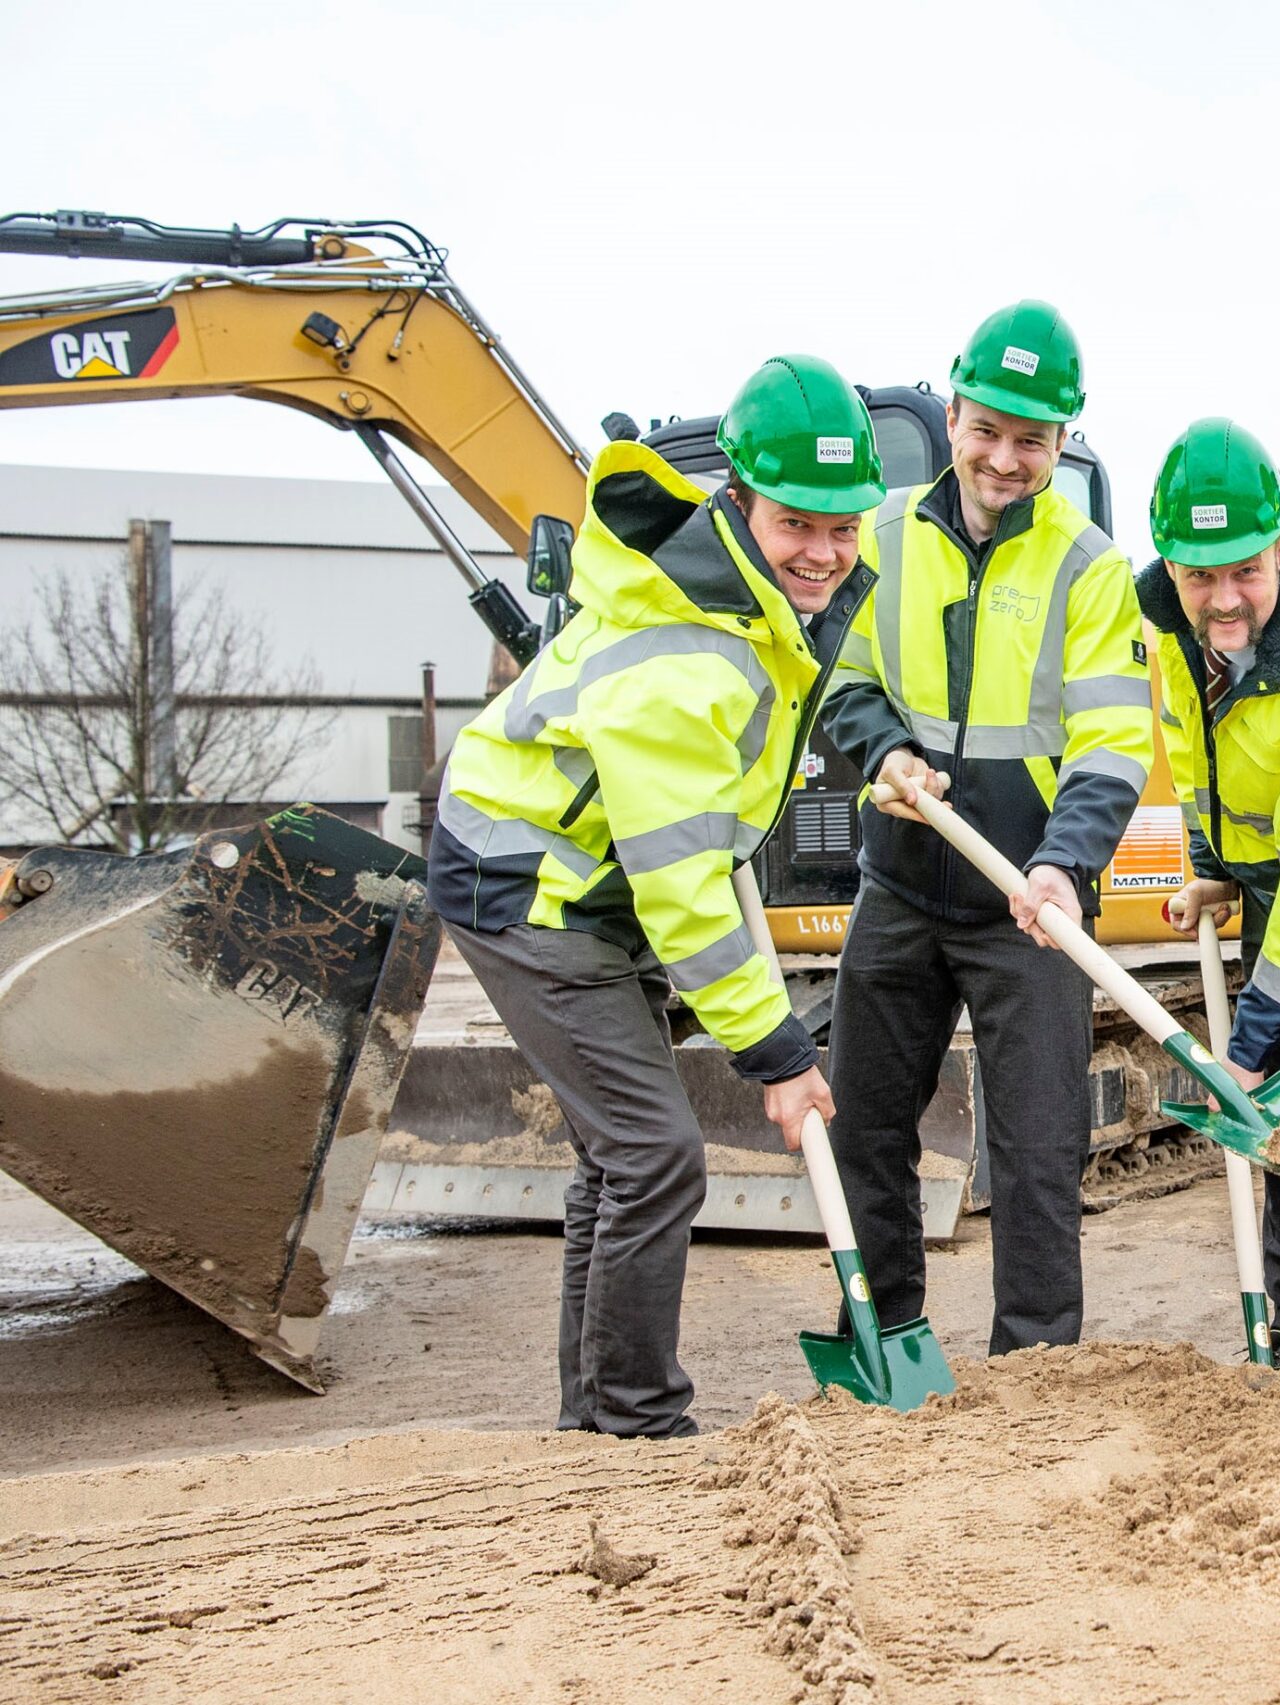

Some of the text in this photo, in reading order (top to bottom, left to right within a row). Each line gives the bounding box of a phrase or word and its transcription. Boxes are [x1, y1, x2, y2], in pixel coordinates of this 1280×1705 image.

[50, 330, 131, 379] CAT
[1005, 356, 1035, 370] KONTOR
[819, 440, 852, 449] SORTIER
[819, 449, 852, 457] KONTOR
[992, 585, 1020, 600] pre
[989, 600, 1024, 620] zero
[235, 958, 323, 1031] CAT
